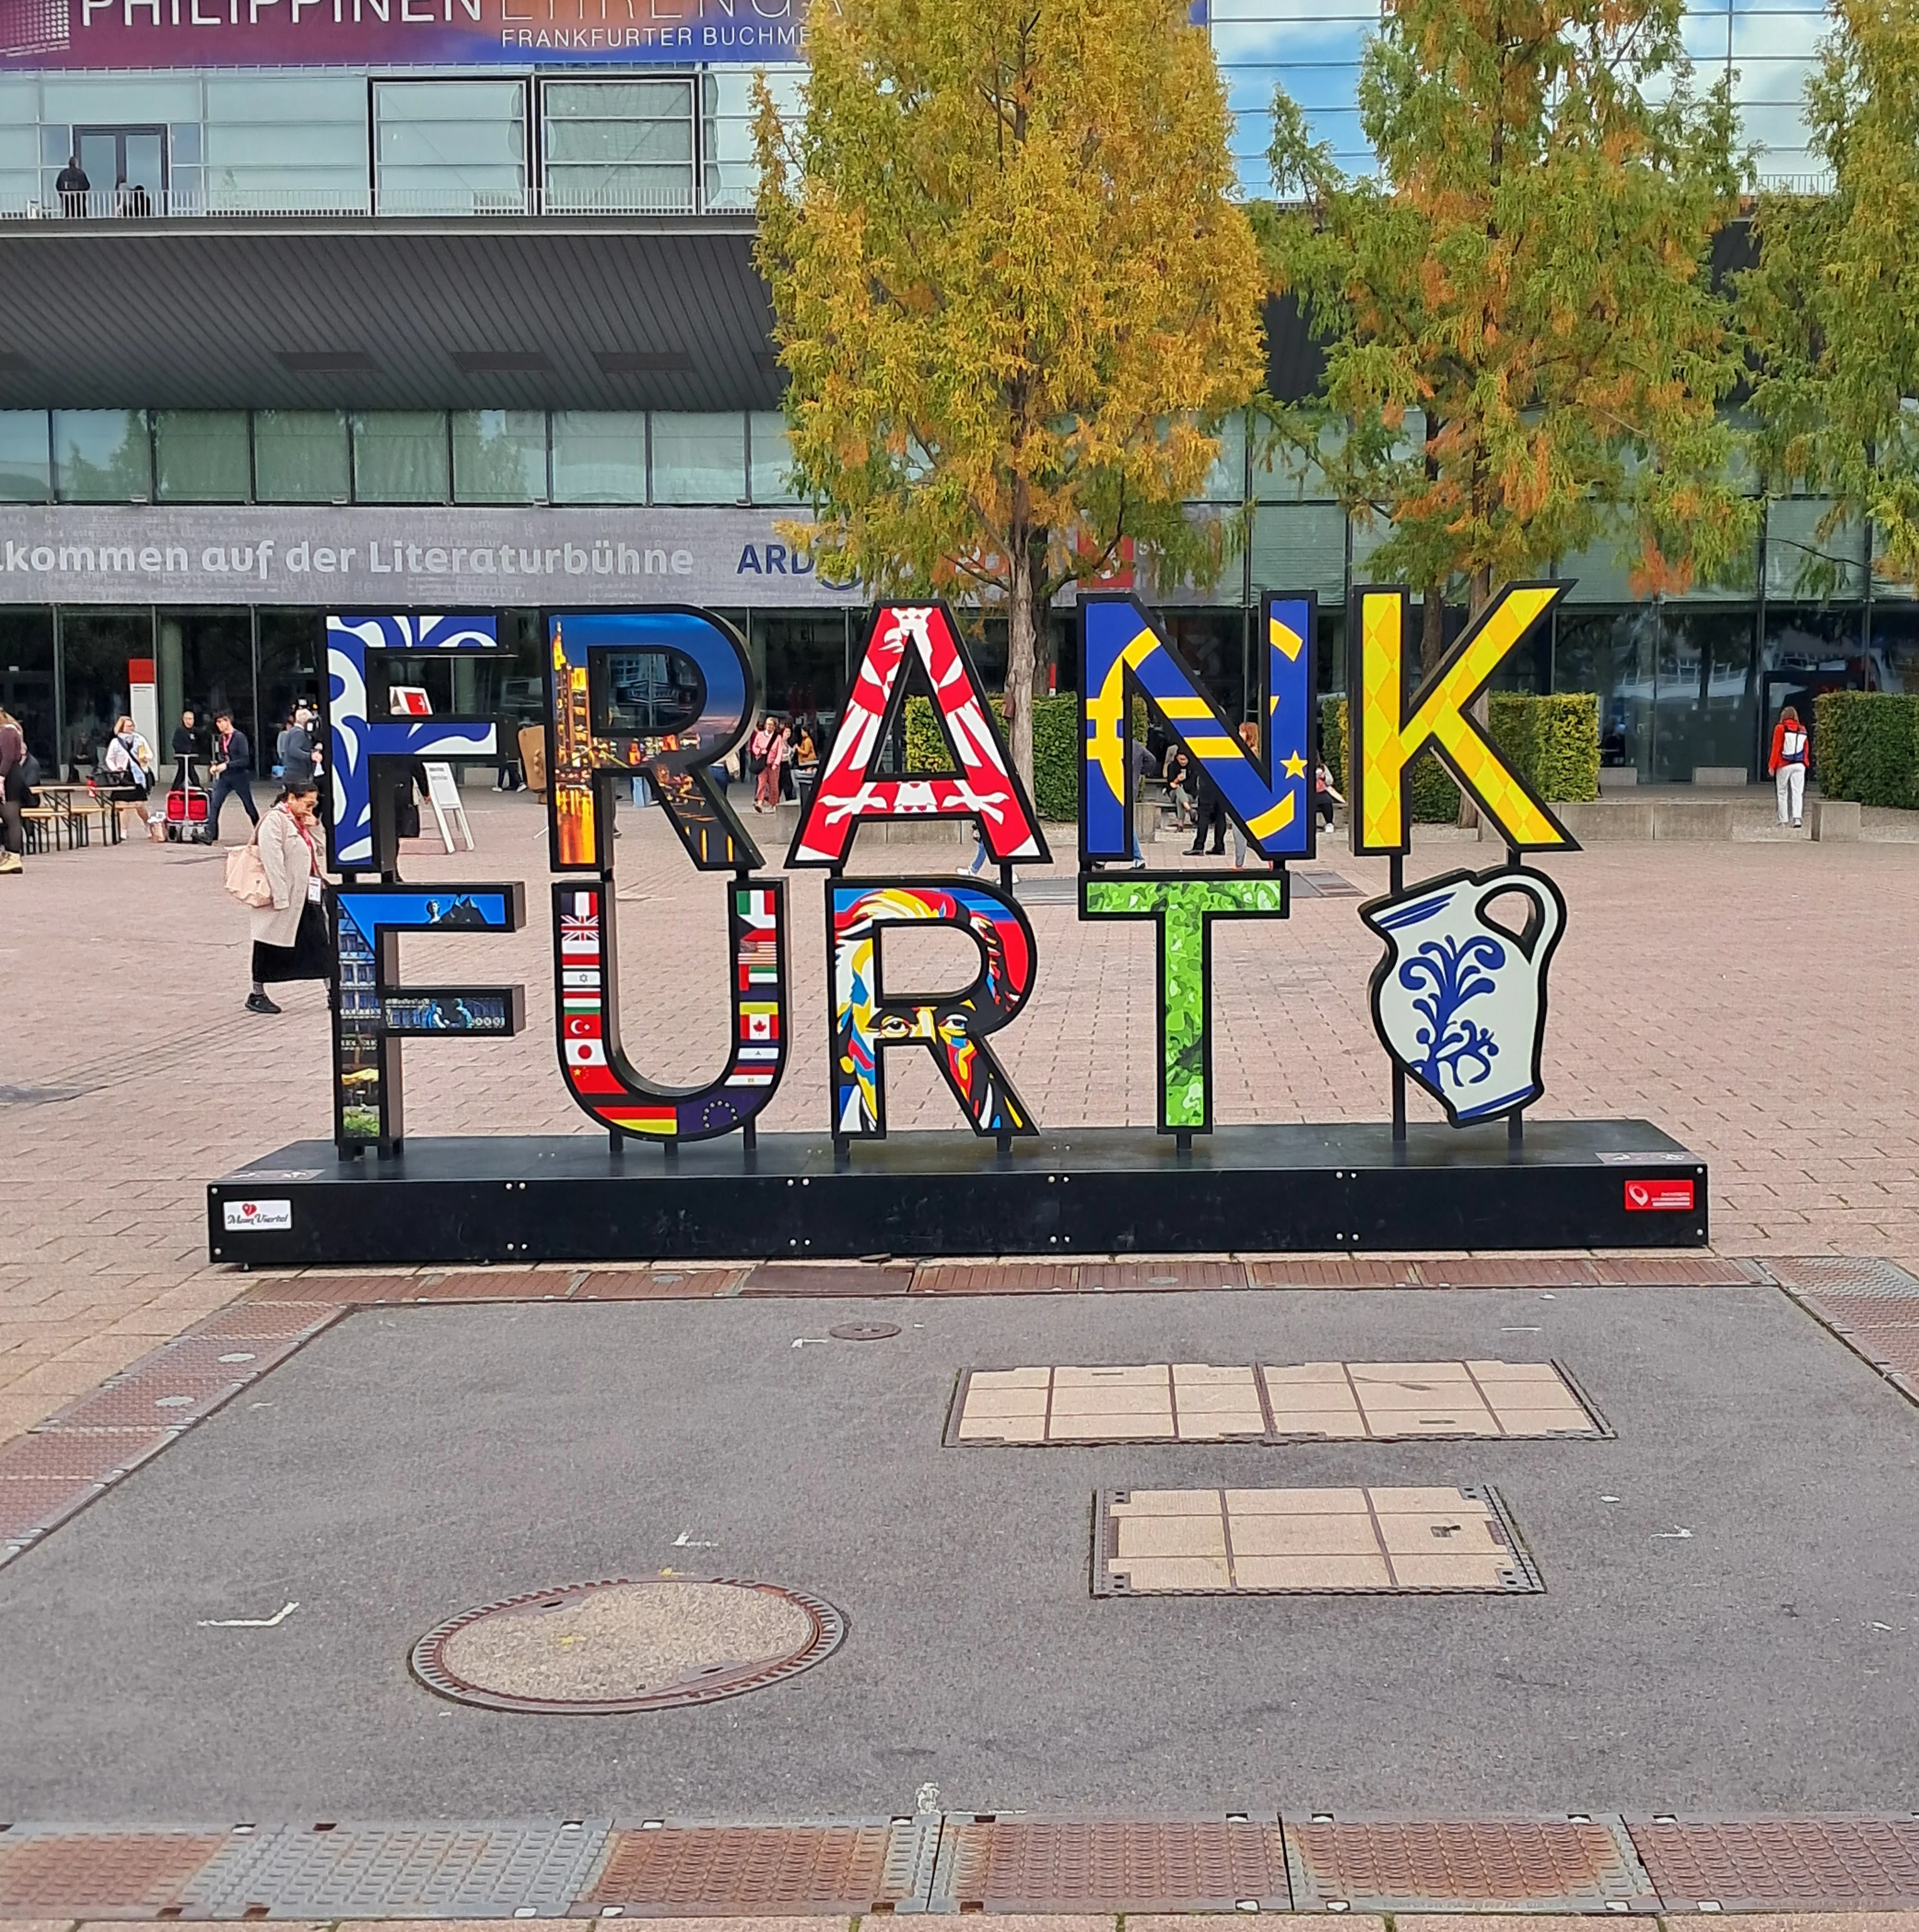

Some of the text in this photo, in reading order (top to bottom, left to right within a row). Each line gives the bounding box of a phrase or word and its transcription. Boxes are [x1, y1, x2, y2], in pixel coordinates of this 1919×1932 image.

[83, 0, 481, 26] PHILIPPINEN
[502, 27, 692, 47] FRANKFURTER
[0, 540, 693, 580] kommen auf der Literaturbühne
[736, 544, 815, 575] ARD
[324, 580, 1580, 872] FRANK
[334, 872, 1290, 1145] FURT
